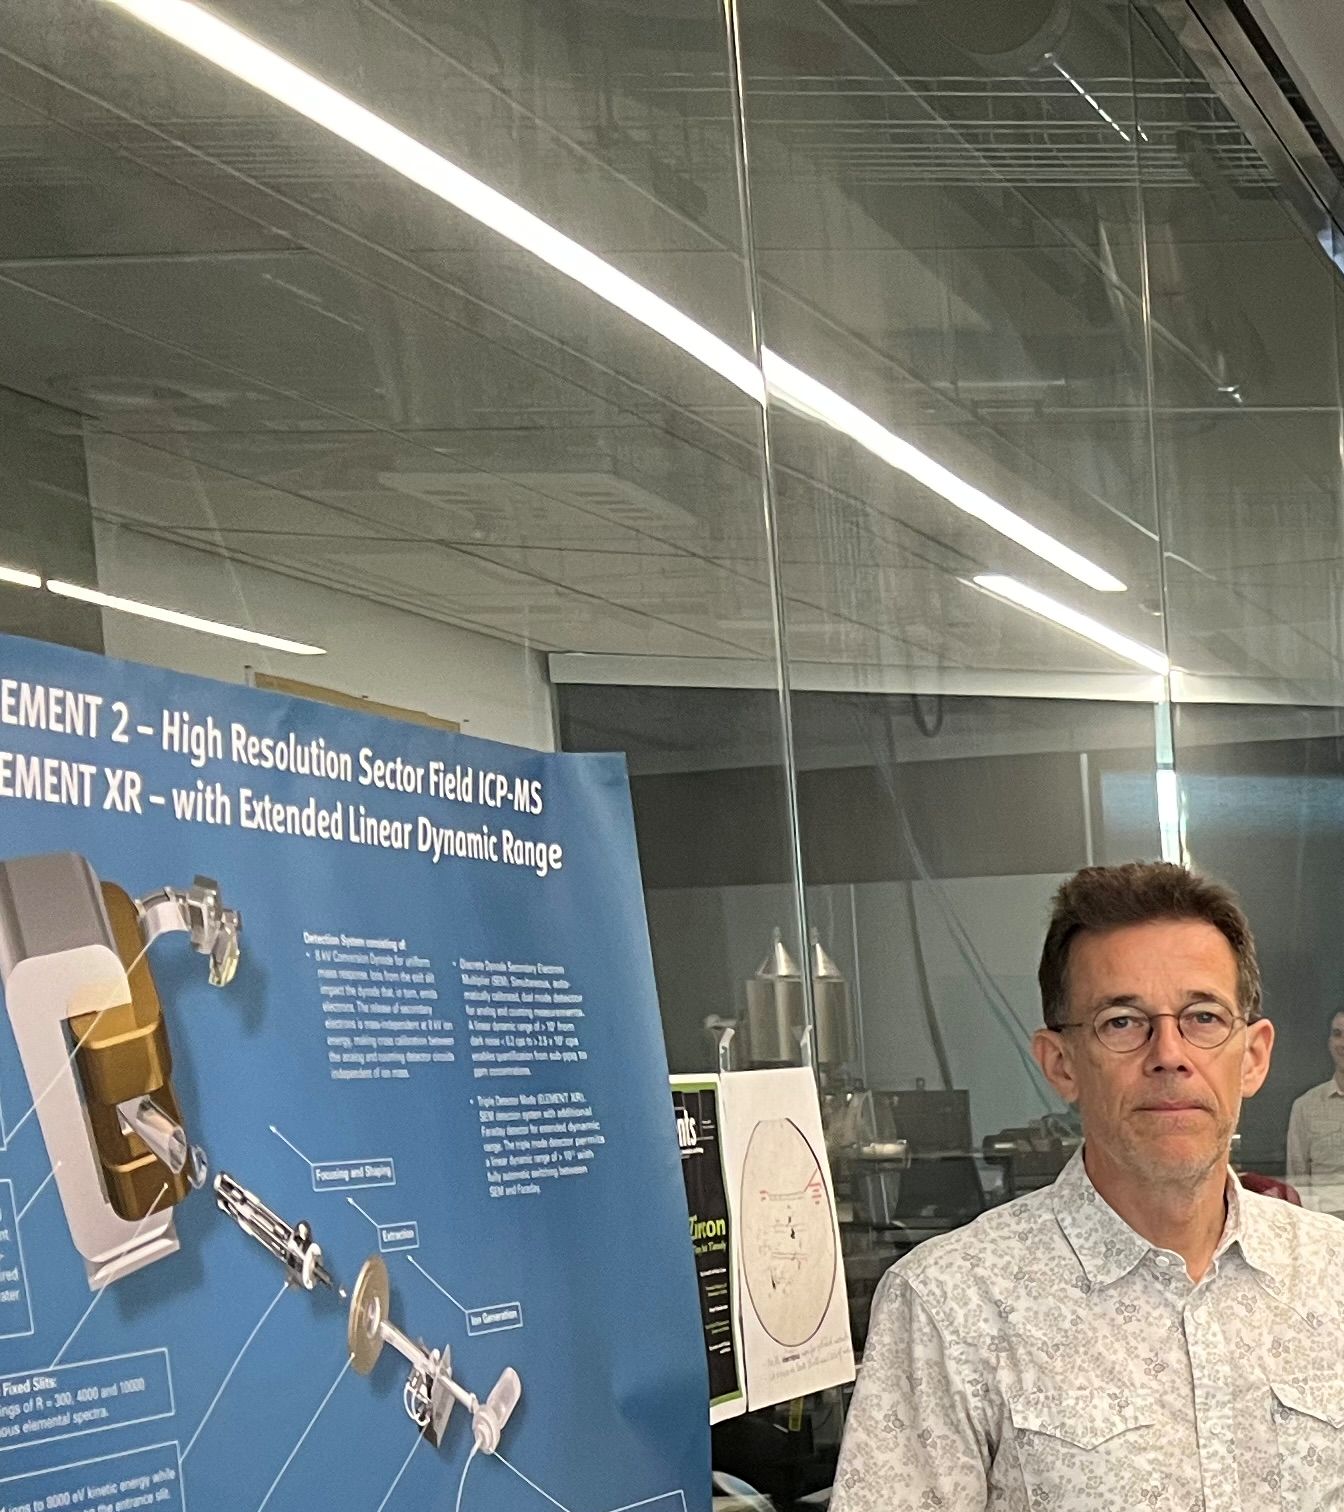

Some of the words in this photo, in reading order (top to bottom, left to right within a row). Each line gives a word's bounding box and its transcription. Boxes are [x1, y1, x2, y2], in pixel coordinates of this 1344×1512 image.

[0, 678, 103, 738] EMENT
[111, 702, 129, 743] 2
[162, 709, 223, 768] High
[230, 723, 352, 782] Resolution
[359, 747, 424, 794] Sector
[429, 760, 473, 803] Field
[478, 770, 543, 815] ICP-MS
[0, 752, 97, 808] EMENT
[103, 767, 142, 815] XR
[172, 780, 231, 825] with
[239, 788, 343, 841] Extended
[349, 805, 413, 851] Linear
[417, 816, 498, 863] Dynamic
[501, 829, 563, 877] Range
[3, 1378, 31, 1397] Fixed
[23, 1398, 33, 1412] of
[35, 1396, 44, 1411] R
[77, 1387, 98, 1402] 4000
[101, 1383, 117, 1398] and
[22, 1412, 70, 1433] elemental
[33, 1500, 45, 1512] to
[46, 1492, 71, 1508] 8000
[72, 1488, 85, 1503] eV
[87, 1482, 118, 1500] kinetic
[119, 1475, 151, 1493] energy
[152, 1468, 176, 1484] while
[115, 1494, 154, 1512] entrance
